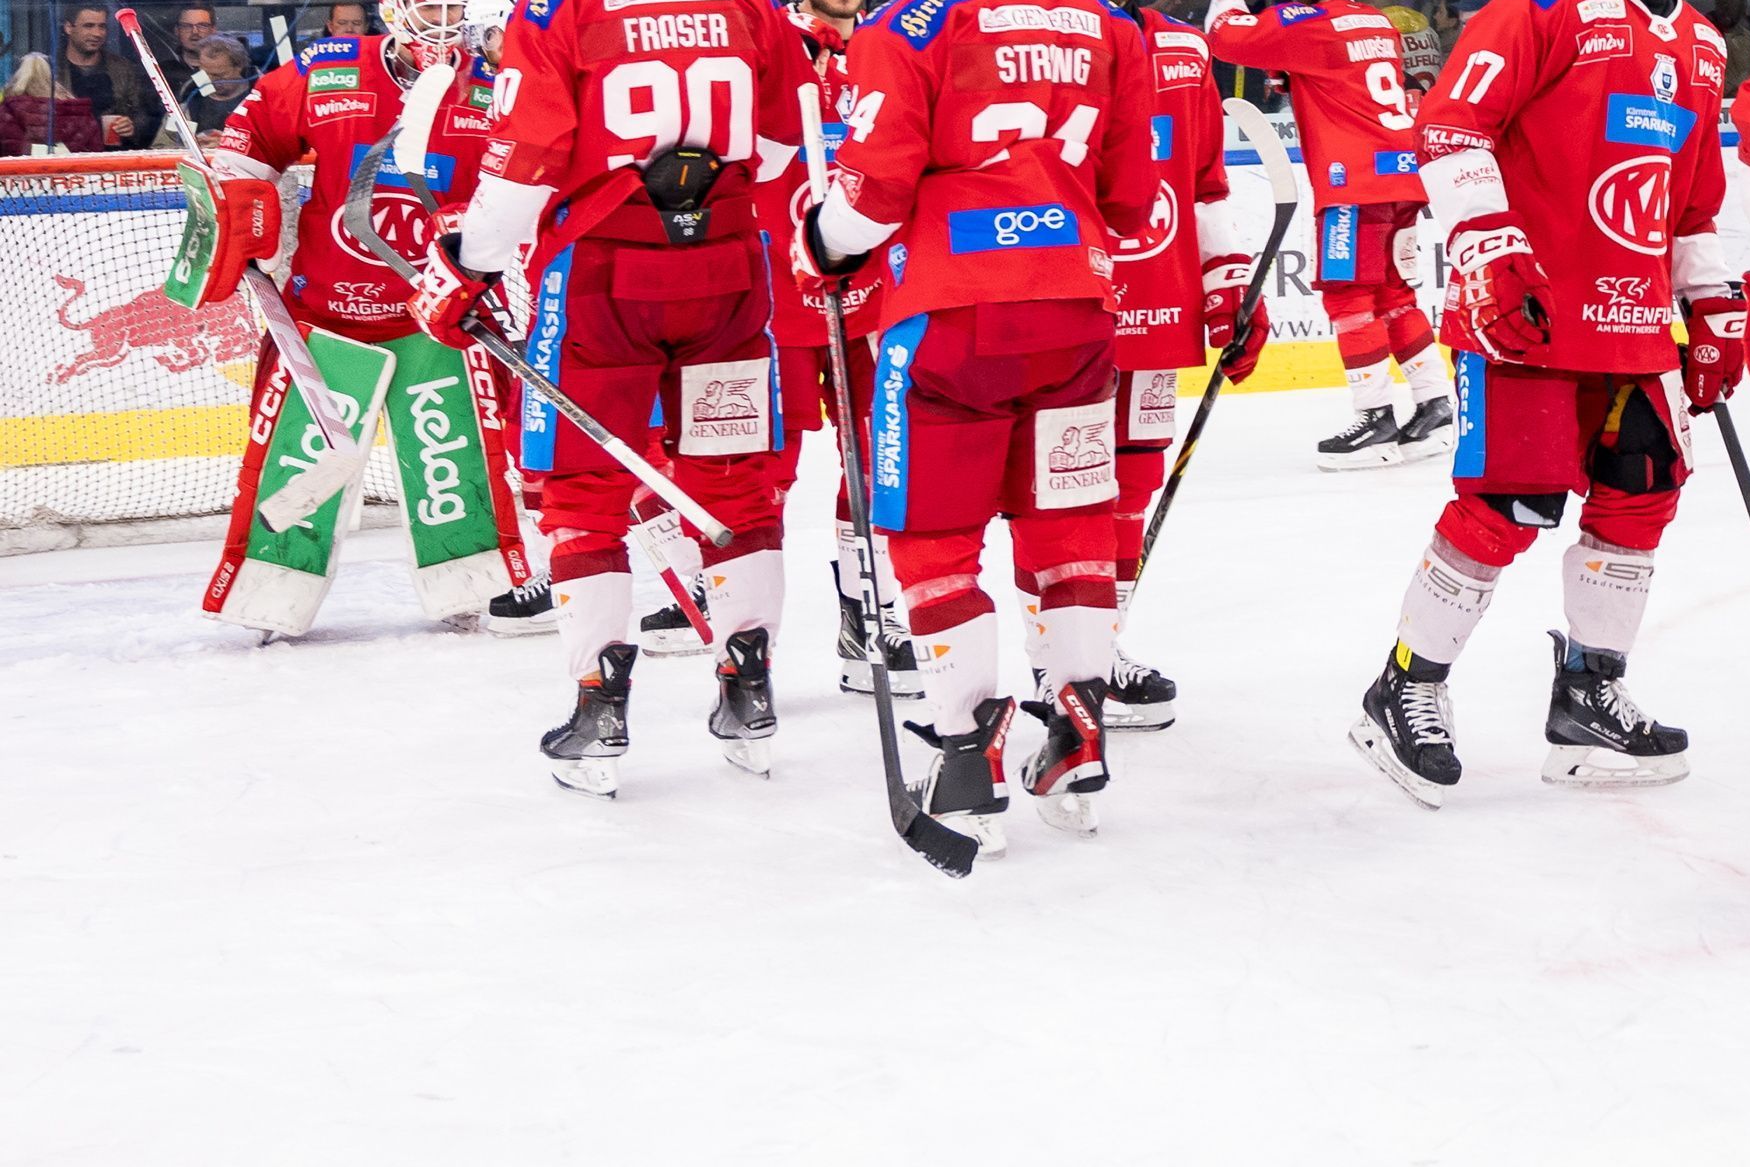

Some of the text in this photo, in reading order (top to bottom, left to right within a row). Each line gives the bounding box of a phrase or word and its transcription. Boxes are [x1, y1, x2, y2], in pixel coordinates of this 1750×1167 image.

[623, 13, 730, 53] FRASER
[309, 70, 359, 89] kelag
[1364, 61, 1415, 131] 9
[1448, 49, 1507, 105] 17
[314, 96, 371, 118] win2day
[1459, 234, 1531, 268] CCM
[250, 357, 291, 446] CCM
[468, 342, 503, 431] CCM
[689, 421, 759, 437] GENERALI
[404, 373, 471, 526] kelag
[1067, 693, 1098, 732] CCM
